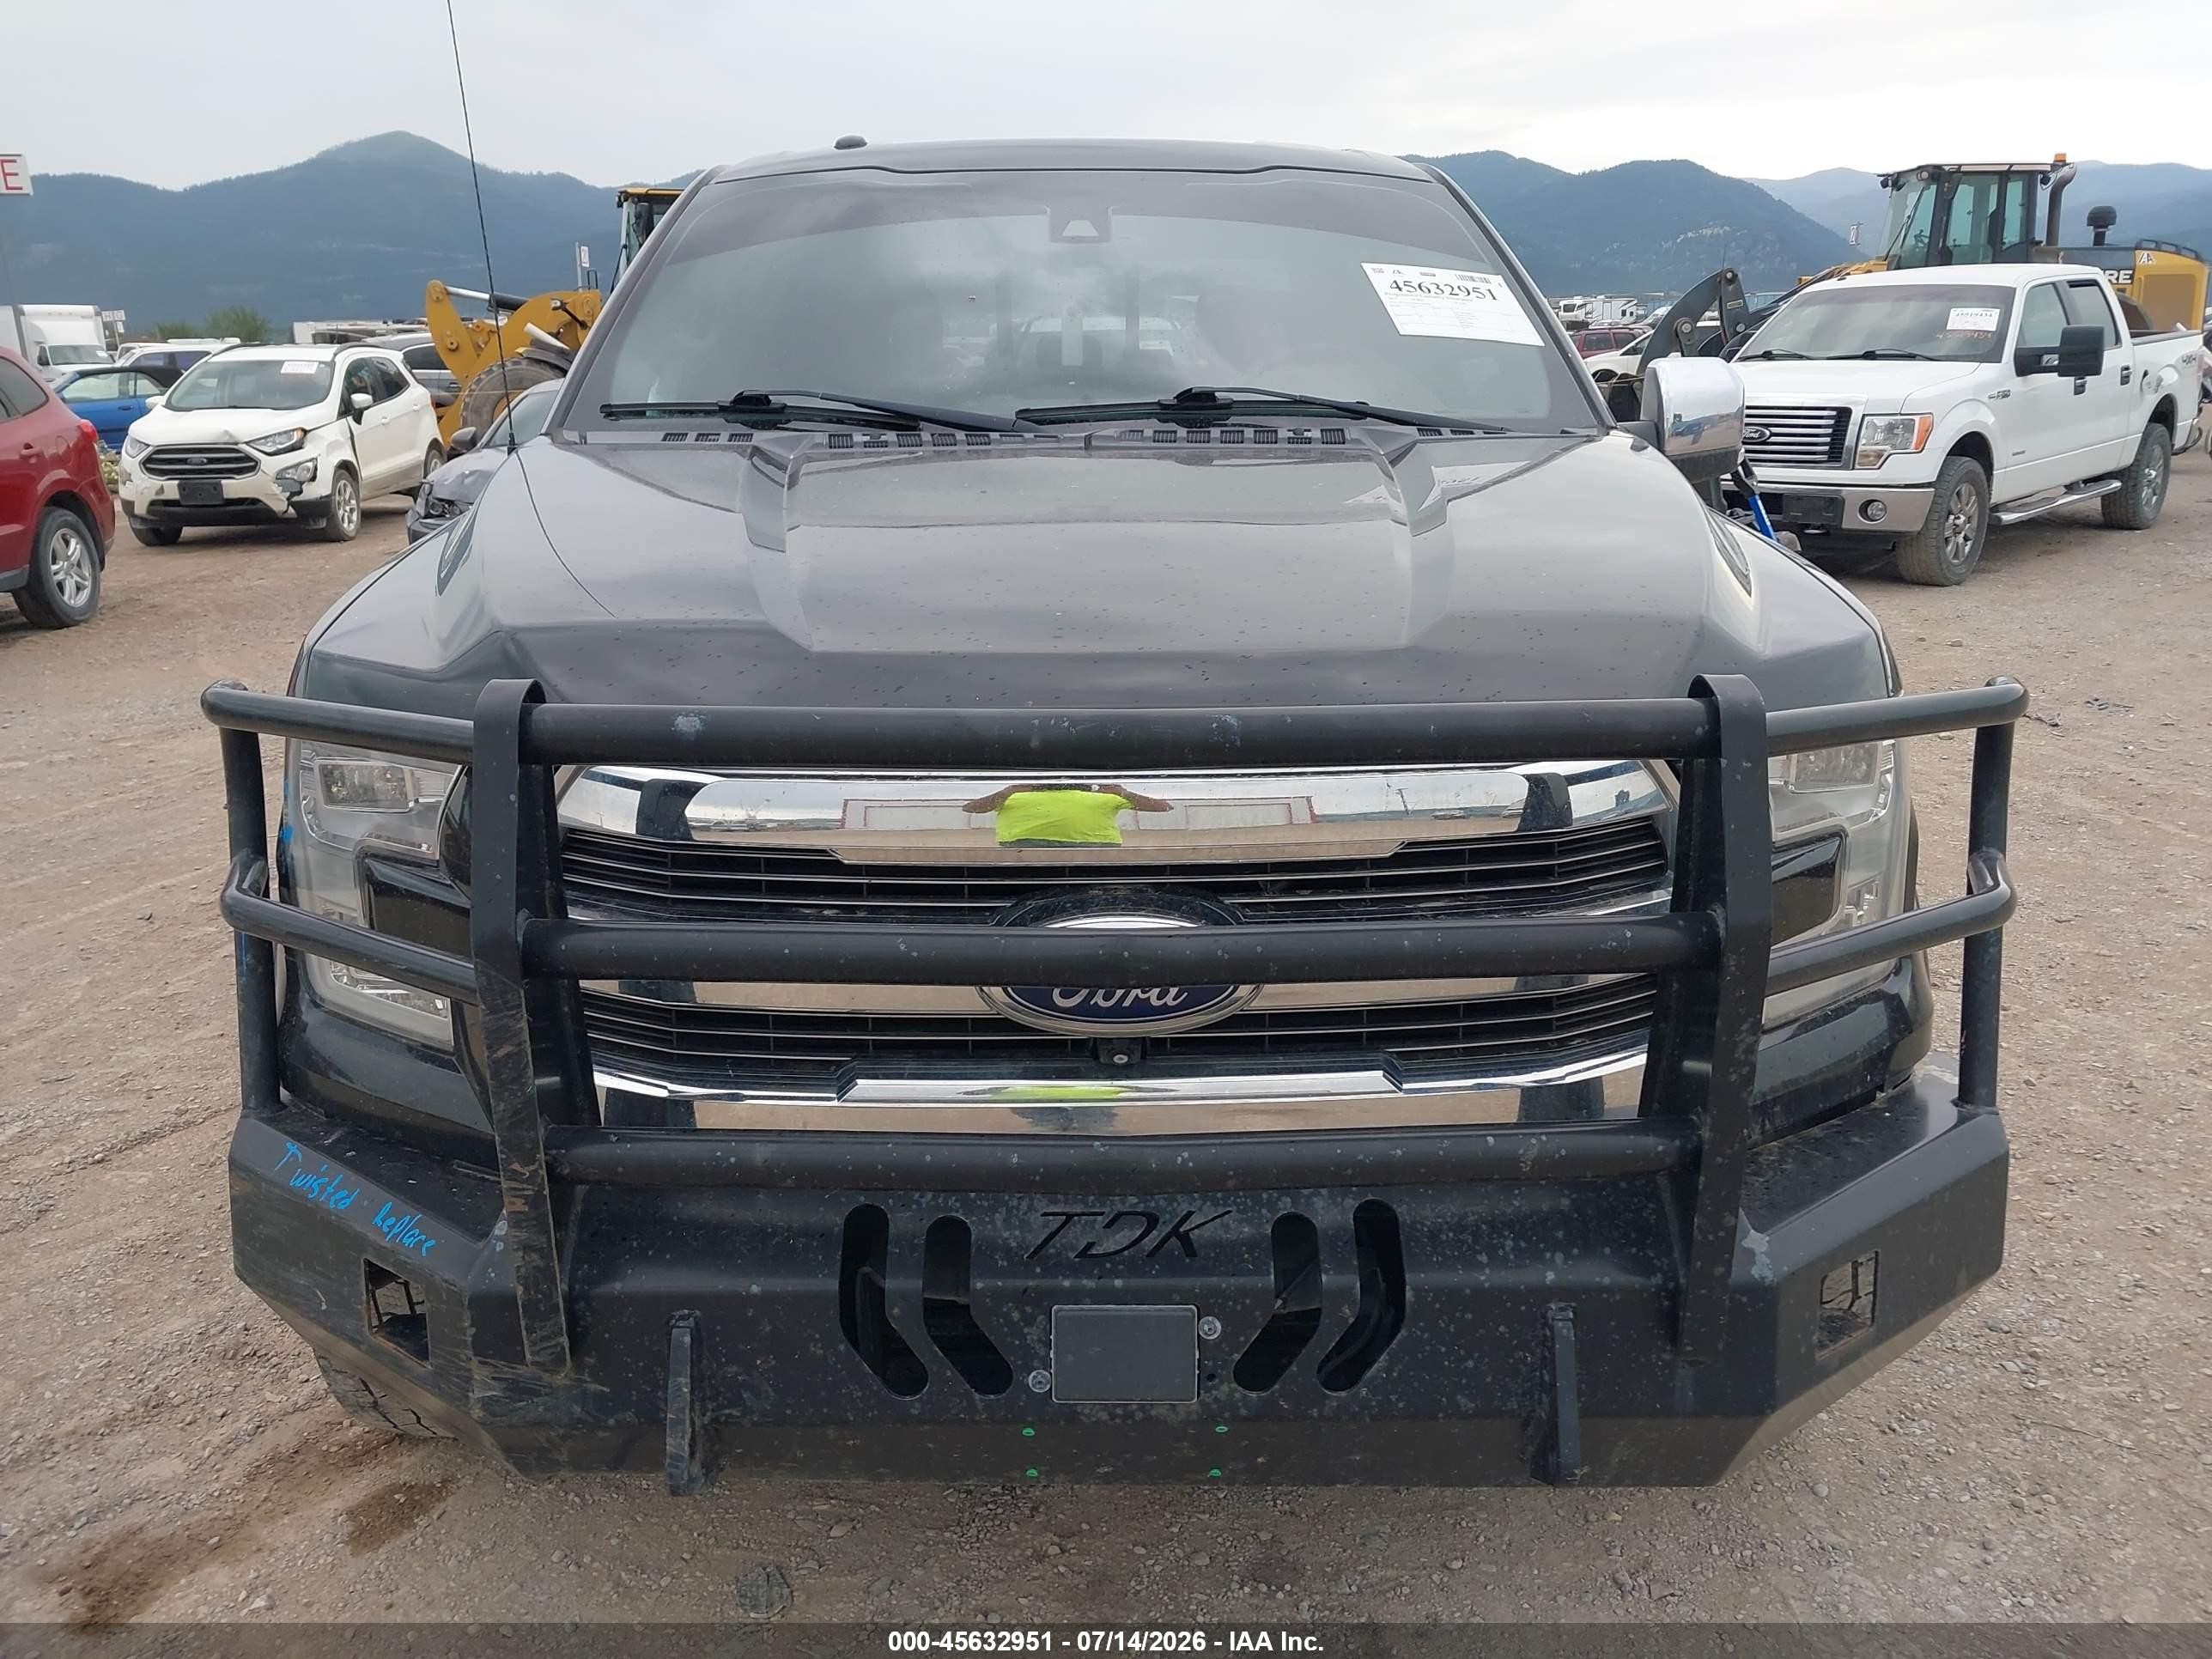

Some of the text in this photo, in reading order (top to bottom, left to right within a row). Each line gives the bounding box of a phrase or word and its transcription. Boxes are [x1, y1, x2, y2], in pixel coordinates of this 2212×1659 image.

[0, 159, 23, 191] E
[1389, 279, 1498, 301] 45632951
[274, 1140, 361, 1210] Twisted
[1024, 1209, 1234, 1259] TDK
